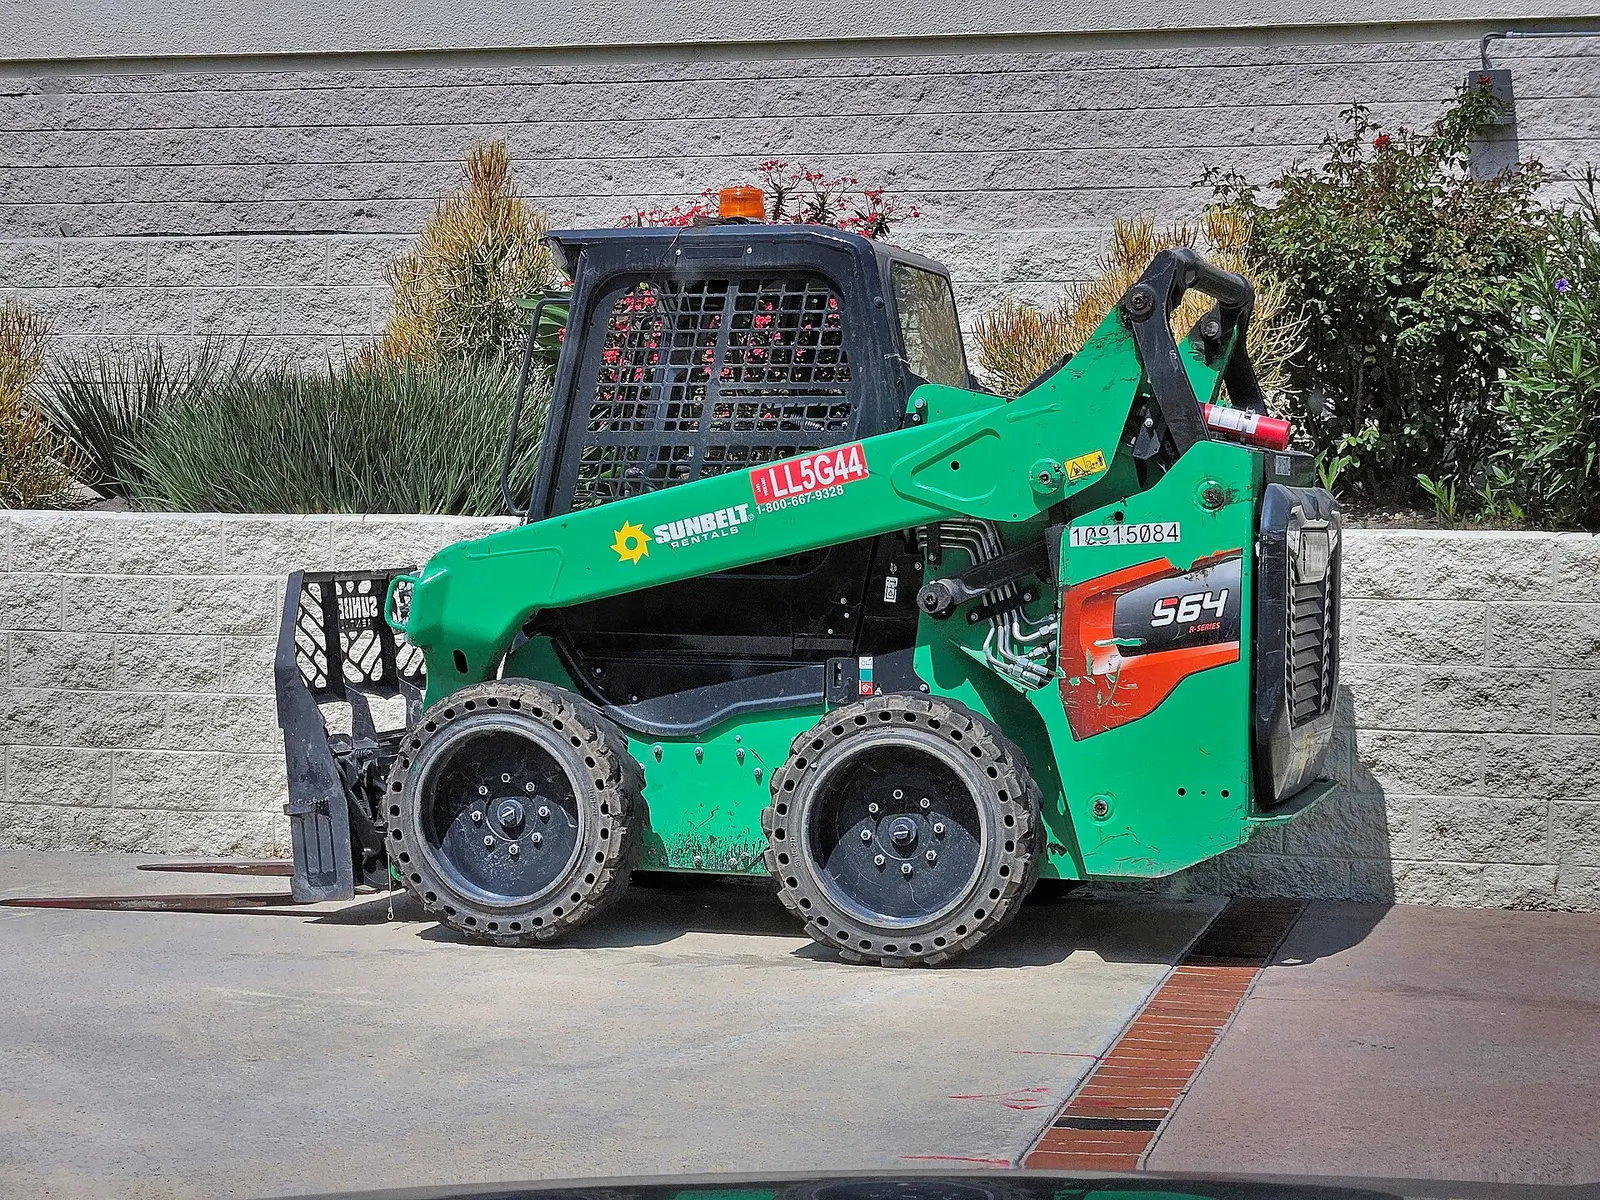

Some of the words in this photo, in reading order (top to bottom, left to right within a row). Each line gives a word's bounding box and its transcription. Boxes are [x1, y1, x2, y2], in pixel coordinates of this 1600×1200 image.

[768, 447, 864, 498] LL5G44
[756, 485, 845, 515] 1-800-667-9328
[653, 503, 749, 544] SUNBELT
[671, 526, 739, 549] RENTALS
[1149, 588, 1230, 628] S64
[1188, 622, 1221, 634] R-SERIES
